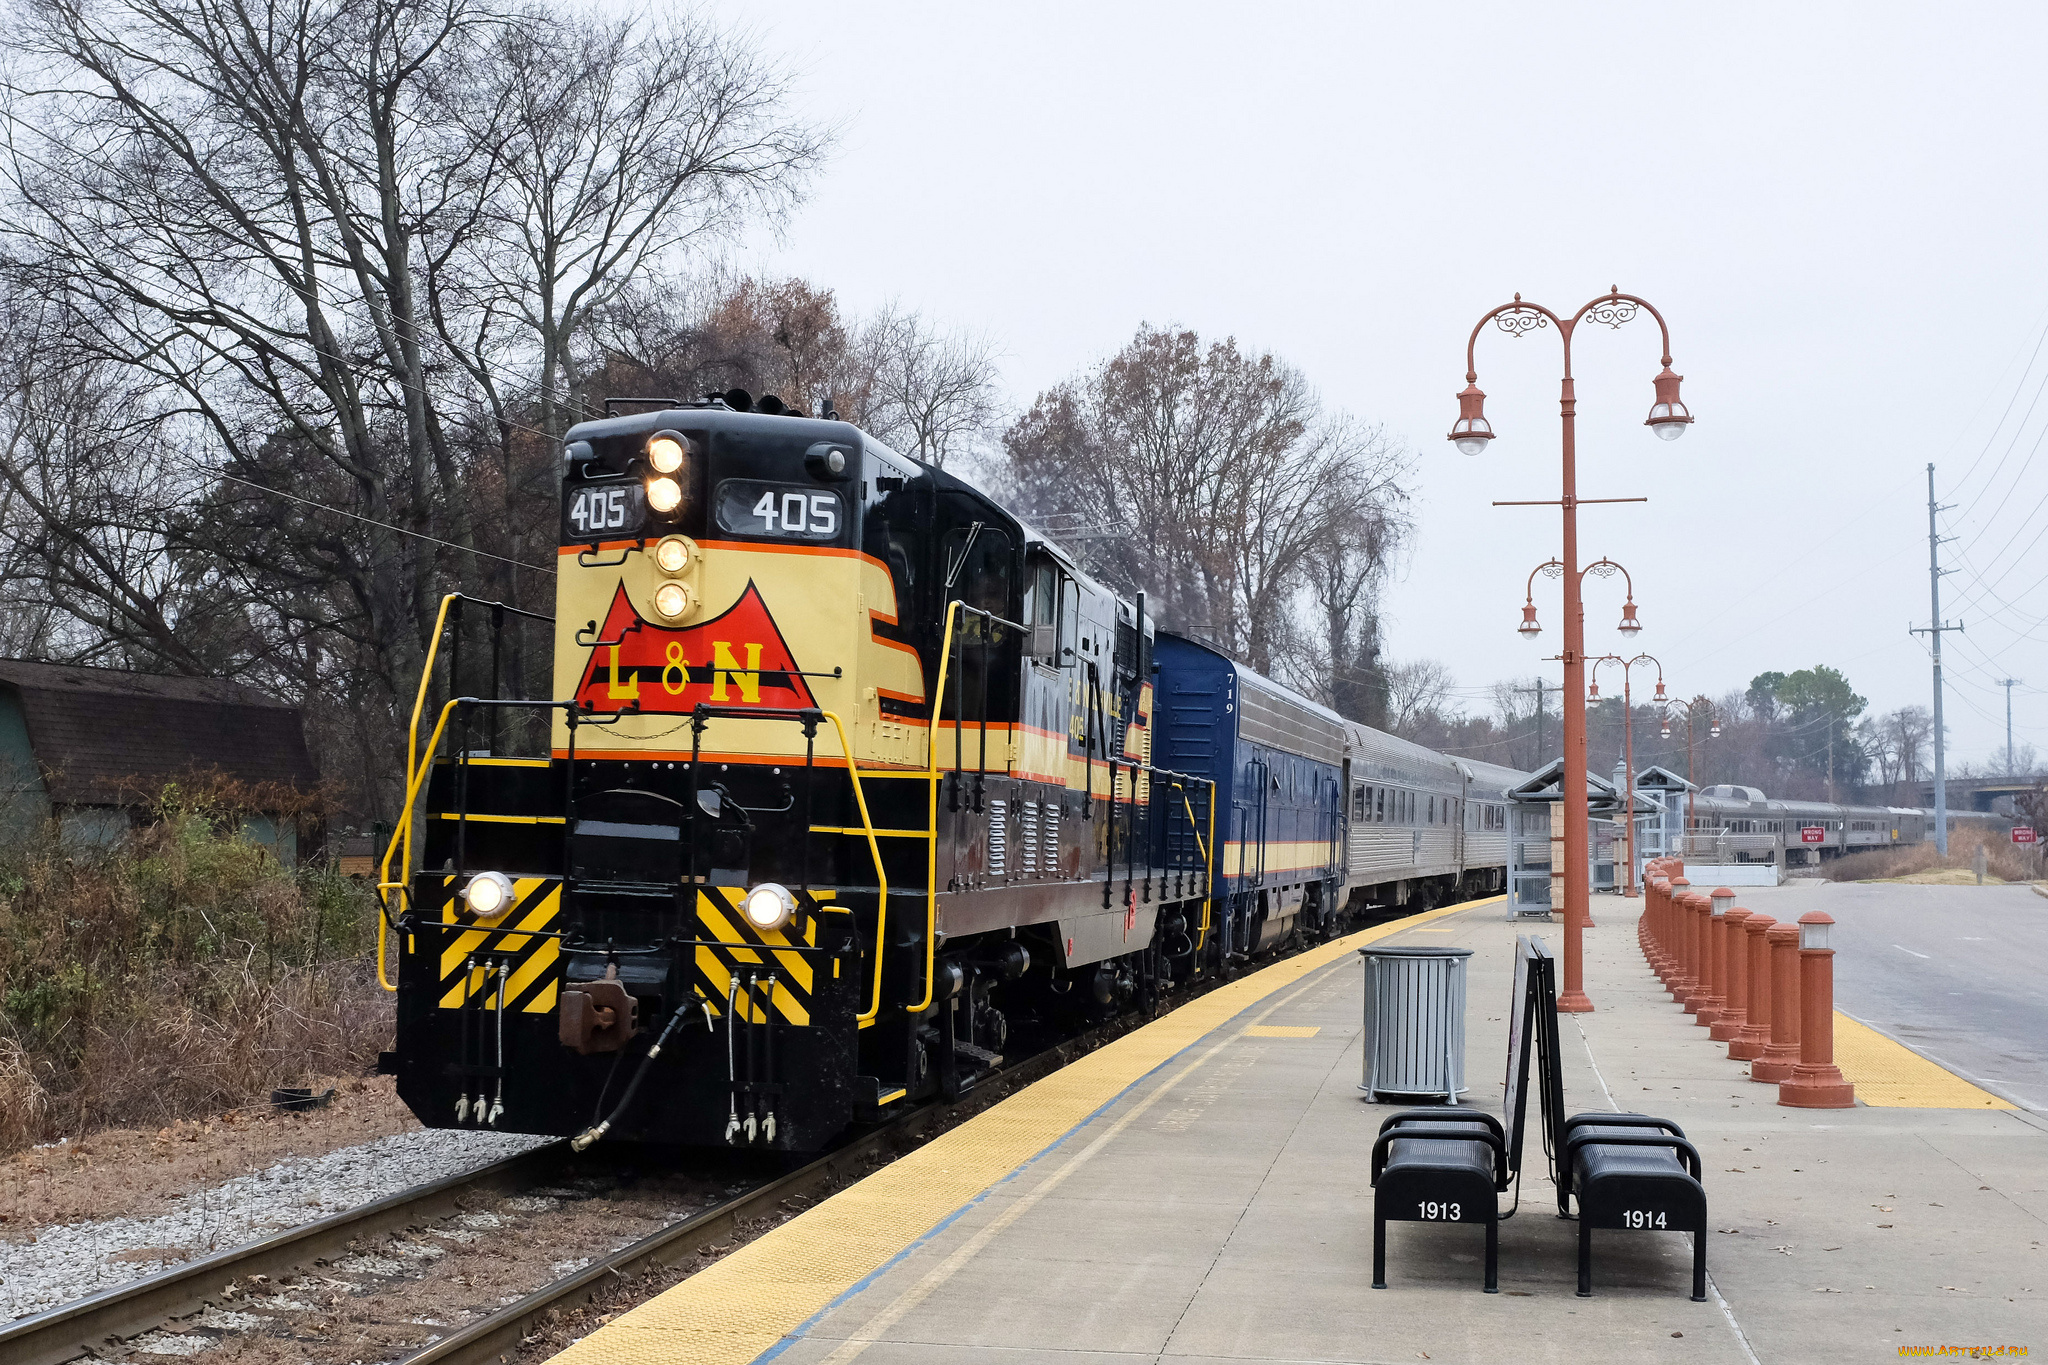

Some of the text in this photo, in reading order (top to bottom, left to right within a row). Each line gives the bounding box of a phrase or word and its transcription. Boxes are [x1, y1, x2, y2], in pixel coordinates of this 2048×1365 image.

[571, 490, 625, 530] 405
[753, 491, 836, 533] 405
[608, 641, 763, 703] L & N
[1226, 673, 1234, 714] 719
[1069, 714, 1084, 740] 405
[1418, 1201, 1461, 1221] 1913
[1622, 1210, 1667, 1230] 1914
